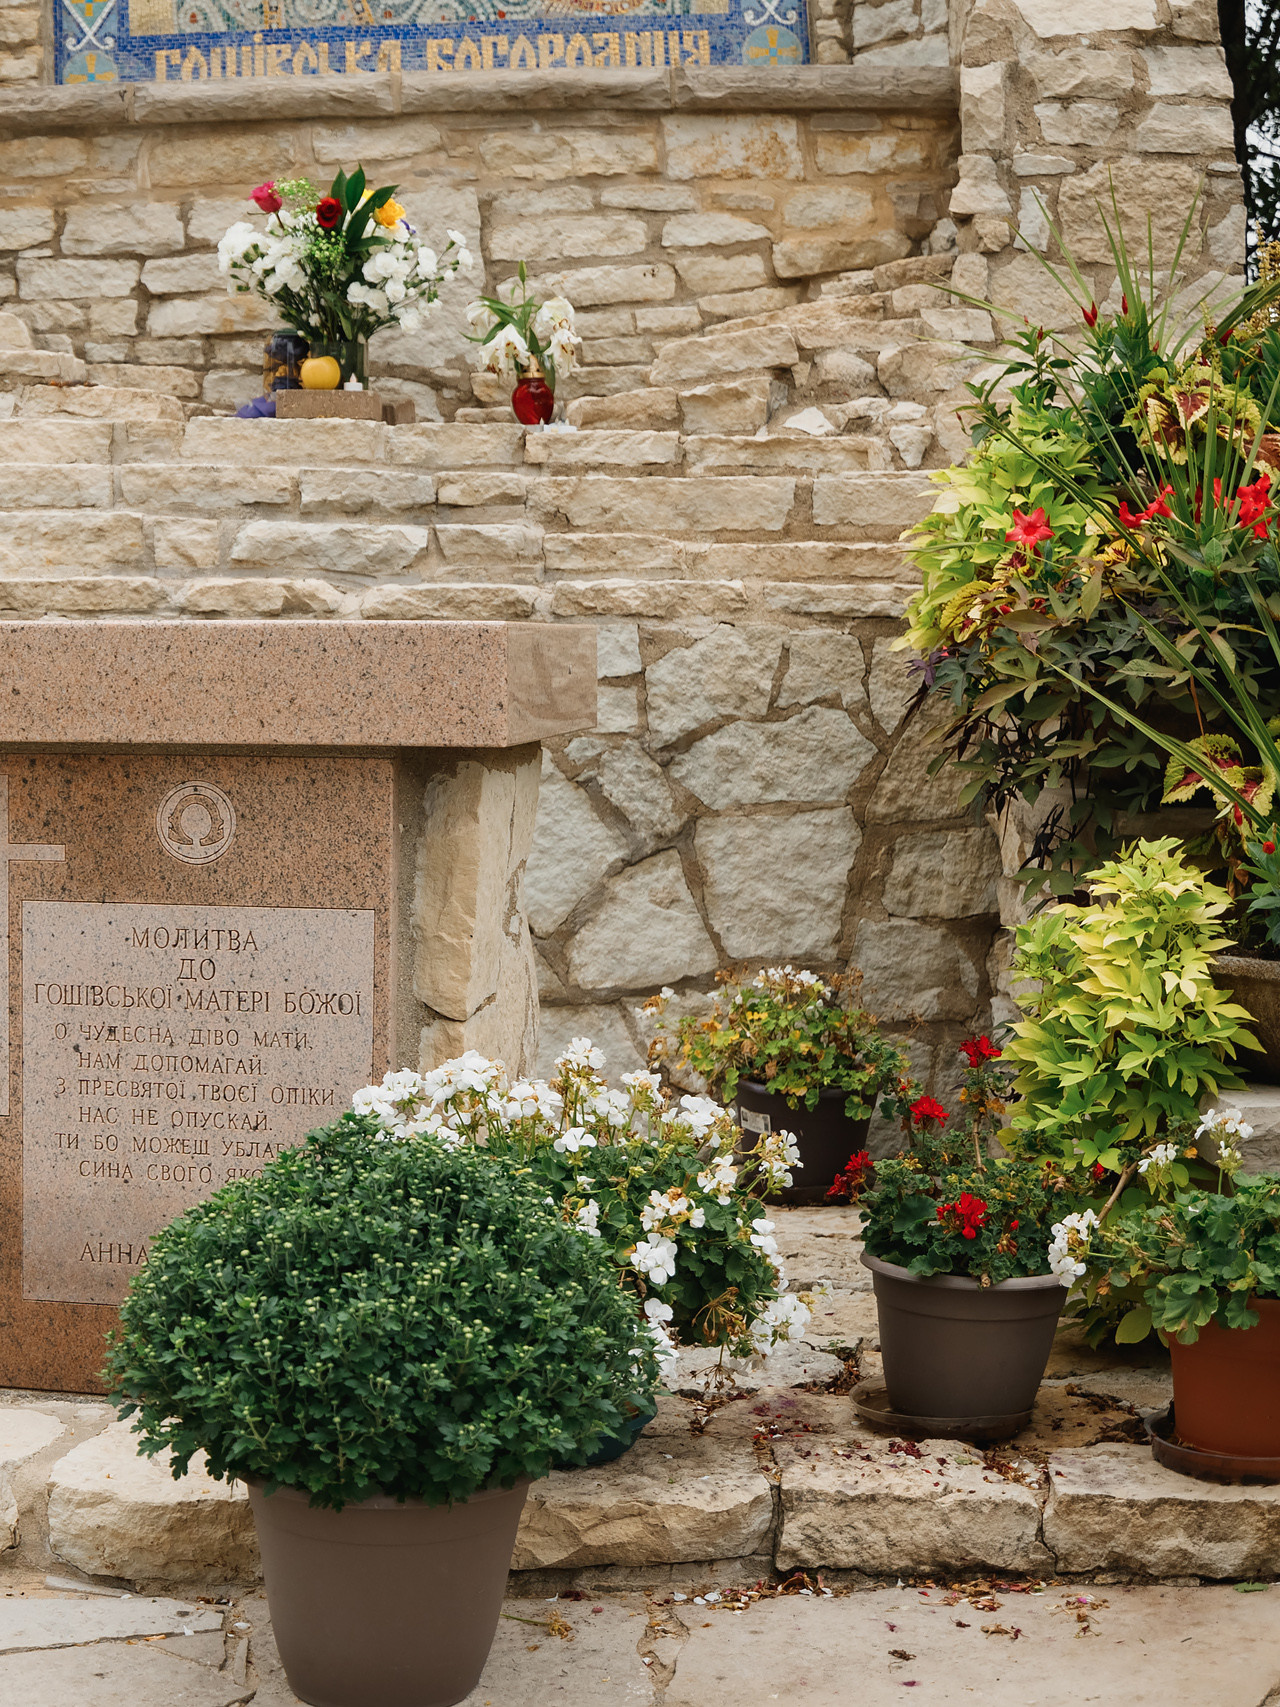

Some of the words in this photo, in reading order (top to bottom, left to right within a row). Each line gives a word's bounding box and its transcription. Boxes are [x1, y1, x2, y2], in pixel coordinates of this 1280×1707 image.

[131, 926, 259, 951] МОЛИТВА
[177, 958, 216, 982] ДО
[34, 983, 173, 1009] ГОШІВСЬКОЇ
[184, 988, 270, 1013] МАТЕРІ
[285, 992, 362, 1016] БОЖОЇ
[80, 1024, 173, 1044] ЧУДЕСНА
[189, 1028, 239, 1048] ДІВО
[79, 1052, 121, 1069] НАМ
[133, 1054, 267, 1076] ДОПОМАГАЙ.
[78, 1079, 185, 1100] ПРЕСВЯТОЇ
[198, 1083, 257, 1103] ТВОЄЇ
[271, 1086, 334, 1106] ОПІКИ
[79, 1106, 118, 1124] НАС
[132, 1109, 159, 1127] НЕ
[171, 1110, 272, 1132] ОПУСКАЙ.
[55, 1132, 79, 1150] ТИ
[94, 1134, 118, 1152] БО
[132, 1137, 210, 1156] МОЖЕШ
[79, 1160, 134, 1179] СИНА
[147, 1164, 212, 1184] СВОГО
[79, 1241, 149, 1264] АННА
